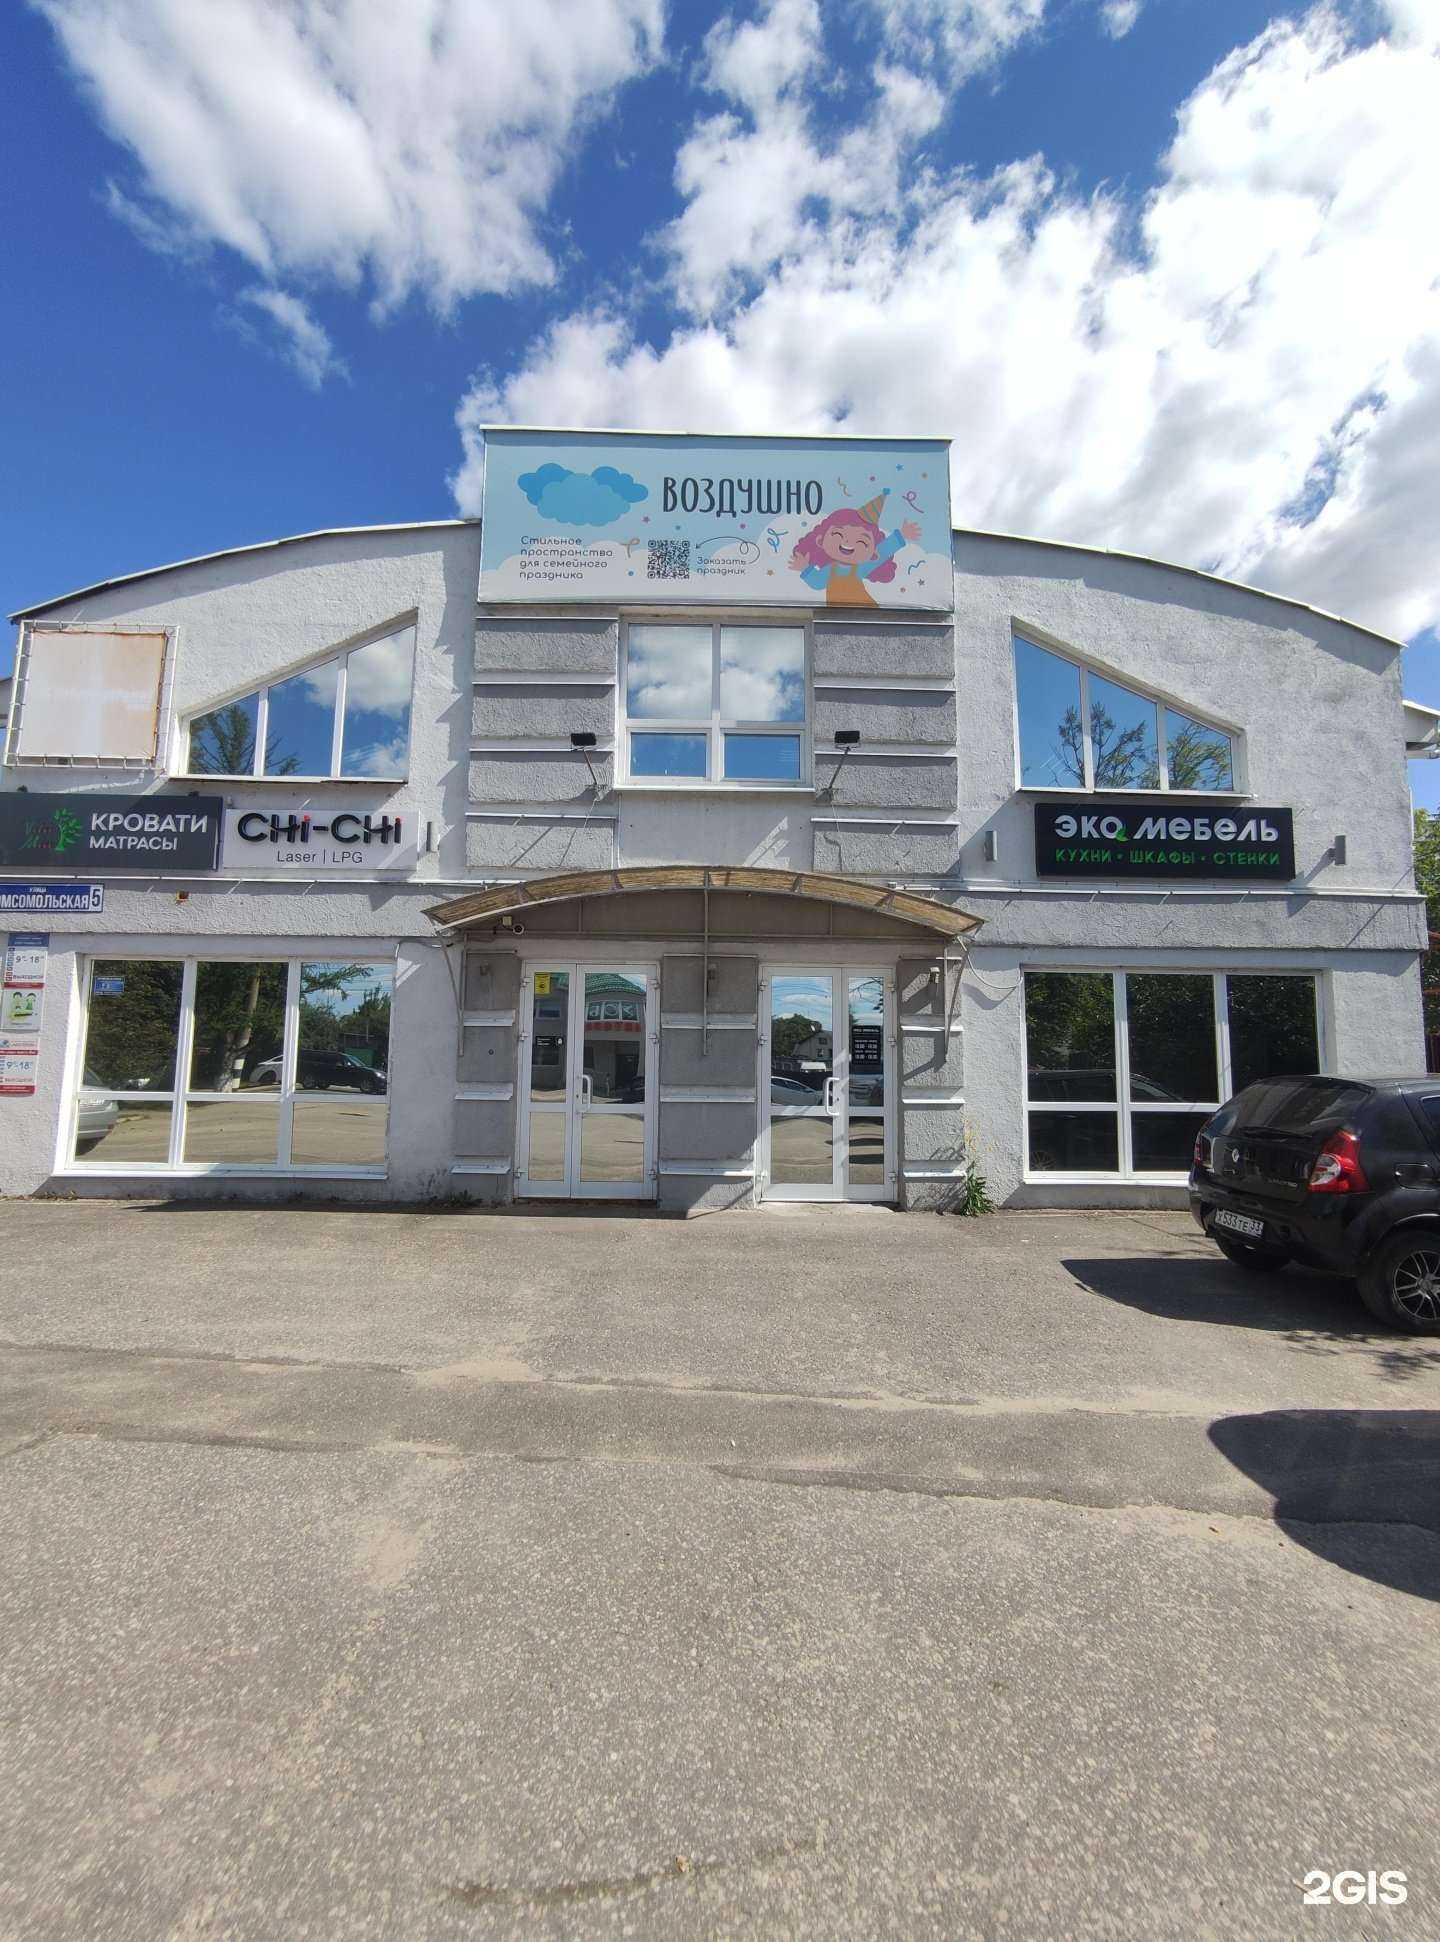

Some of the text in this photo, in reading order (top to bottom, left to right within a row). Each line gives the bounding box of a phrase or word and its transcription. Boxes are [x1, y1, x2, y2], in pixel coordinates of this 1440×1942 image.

[663, 476, 823, 518] ВОЗДУШНО
[520, 535, 583, 546] Стильное
[520, 548, 613, 558] пространства
[519, 558, 608, 570] для семейного
[696, 556, 747, 565] Заказать
[519, 571, 584, 581] праздника
[696, 567, 746, 576] праздник
[90, 812, 208, 833] КРОВАТИ
[1055, 815, 1125, 840] ЭКО
[88, 835, 178, 851] МАТРАСЫ
[276, 851, 363, 864] Laser LPG
[1055, 848, 1281, 866] КУХНИ ШКАФЫ СТЕНКИ
[0, 888, 101, 909] МСОМОЛЬСКАЯ 5
